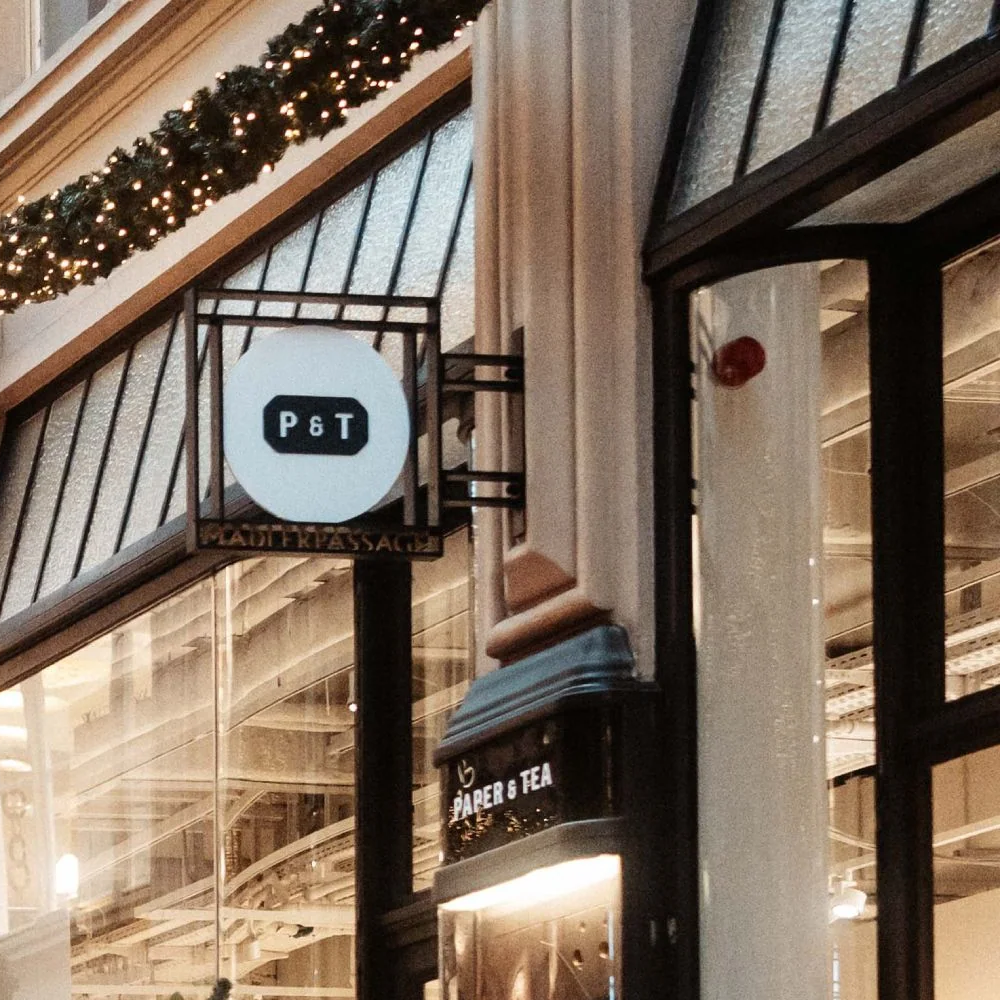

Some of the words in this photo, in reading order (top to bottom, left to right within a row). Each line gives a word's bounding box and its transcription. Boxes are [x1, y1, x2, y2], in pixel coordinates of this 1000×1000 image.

[279, 411, 298, 438] P
[309, 416, 324, 437] &
[334, 413, 354, 439] T
[453, 780, 504, 822] PAPER
[507, 779, 516, 800] &
[519, 762, 553, 794] TEA
